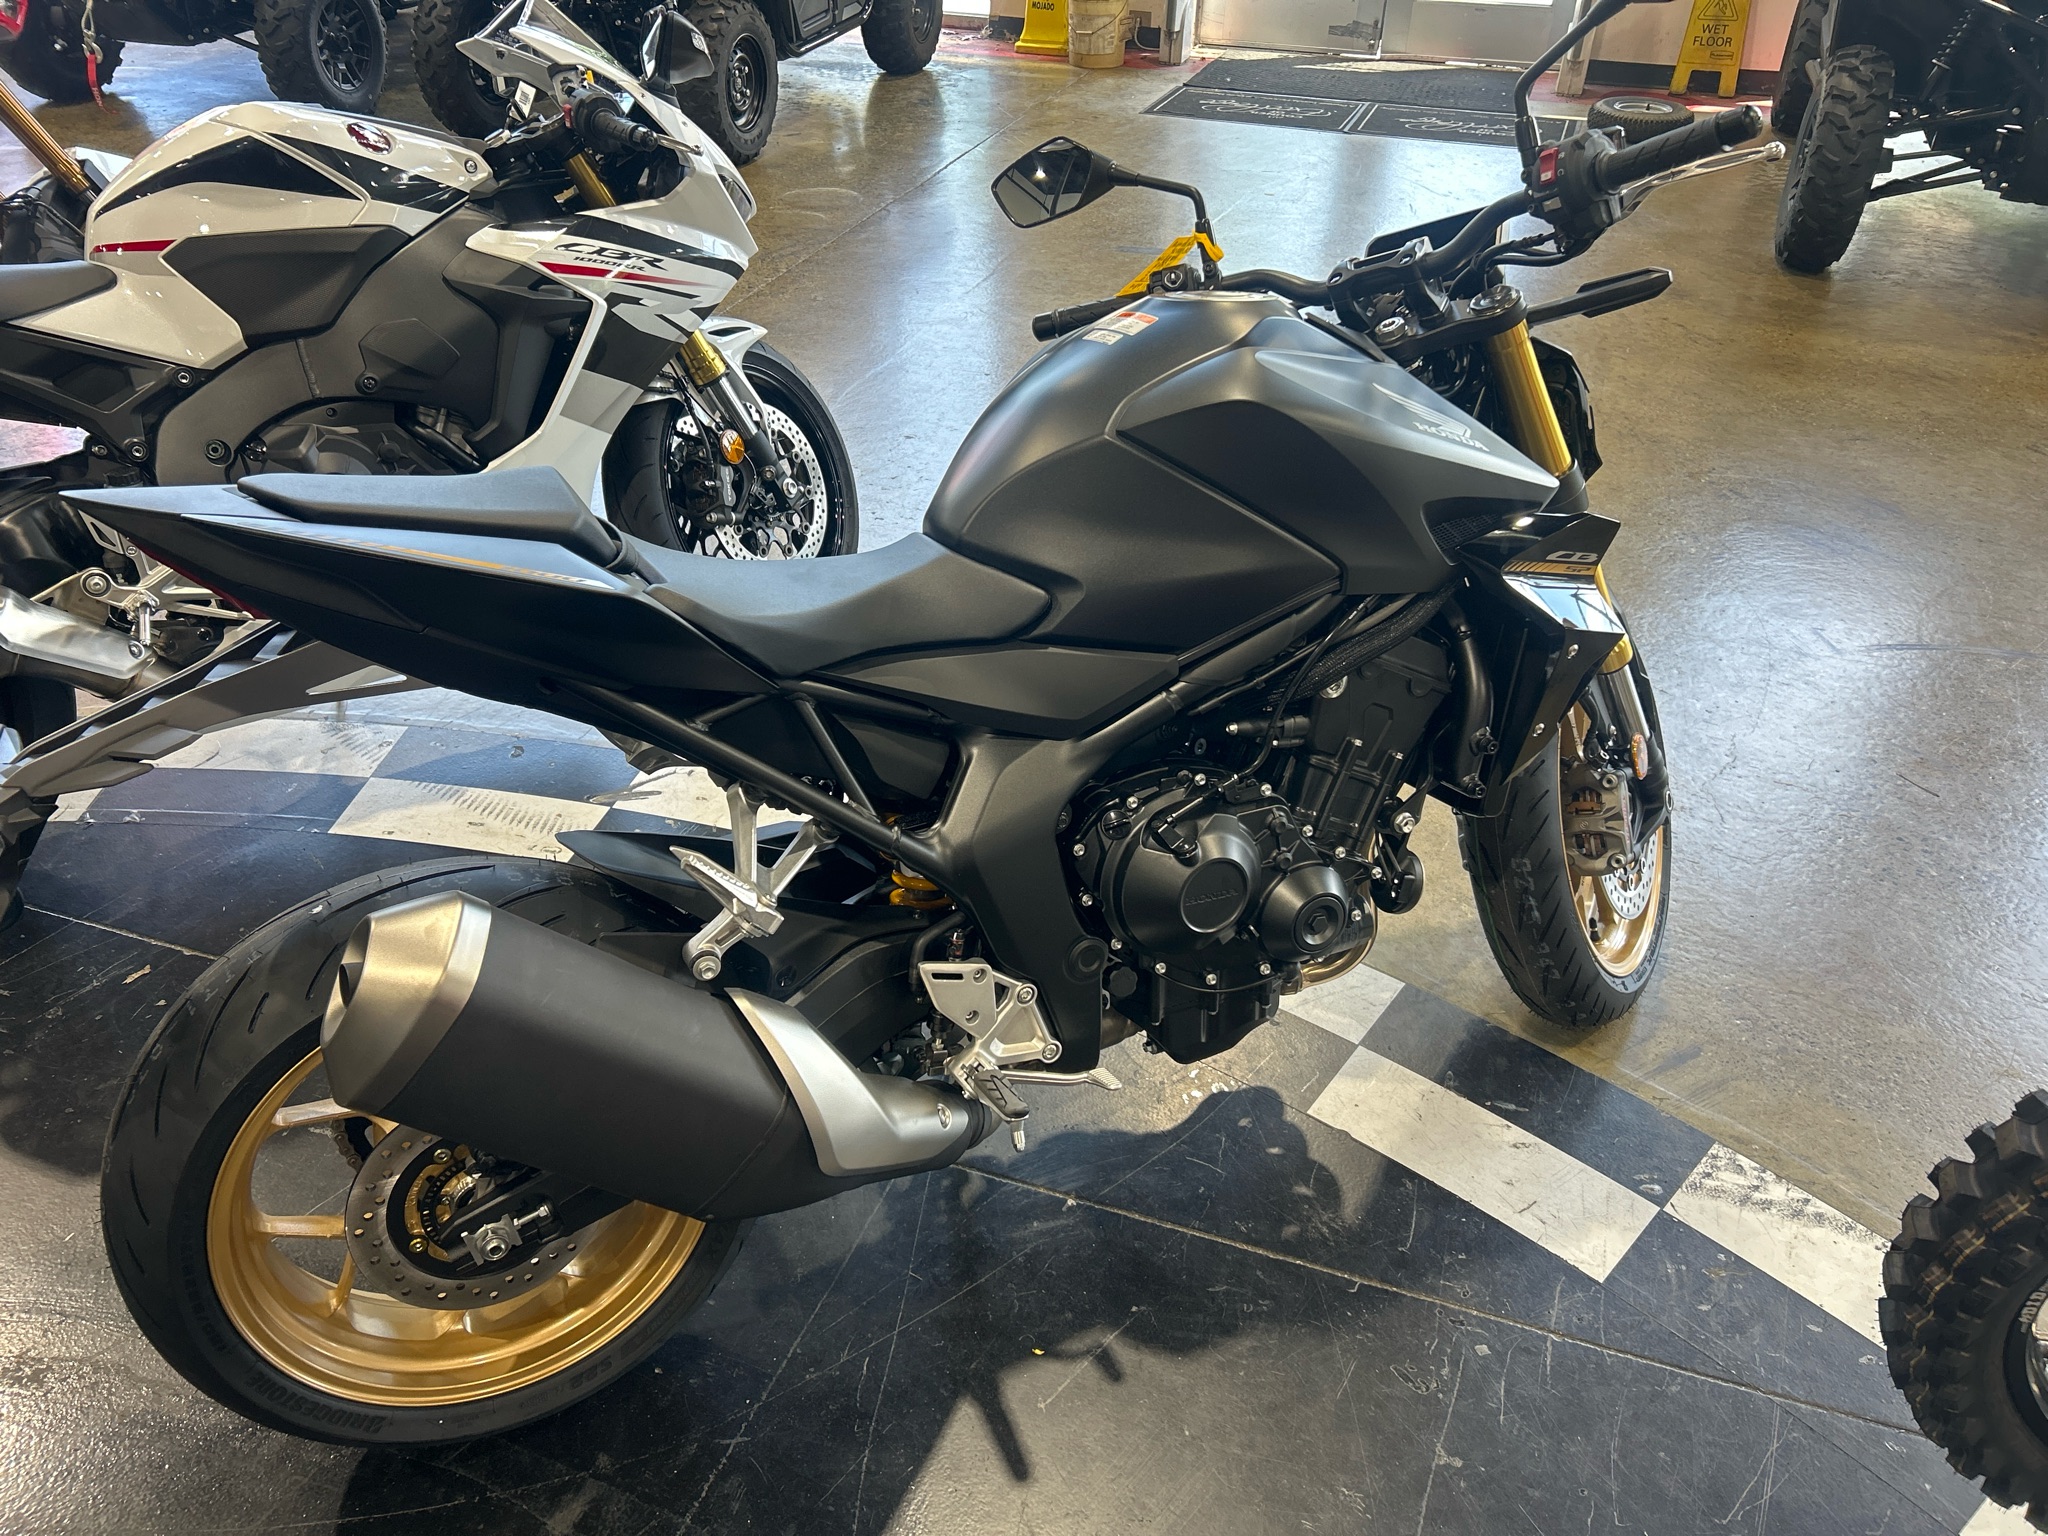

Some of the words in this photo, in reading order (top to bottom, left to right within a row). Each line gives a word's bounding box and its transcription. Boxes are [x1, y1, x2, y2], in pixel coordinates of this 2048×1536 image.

[1032, 1, 1055, 11] MOJADO
[1702, 24, 1729, 34] WET
[1693, 36, 1733, 47] FLOOR
[553, 242, 669, 272] CBR
[1545, 550, 1600, 563] CB
[1563, 565, 1592, 573] SP
[1185, 888, 1240, 907] HONDA
[243, 1372, 388, 1434] BRIDGESTONE
